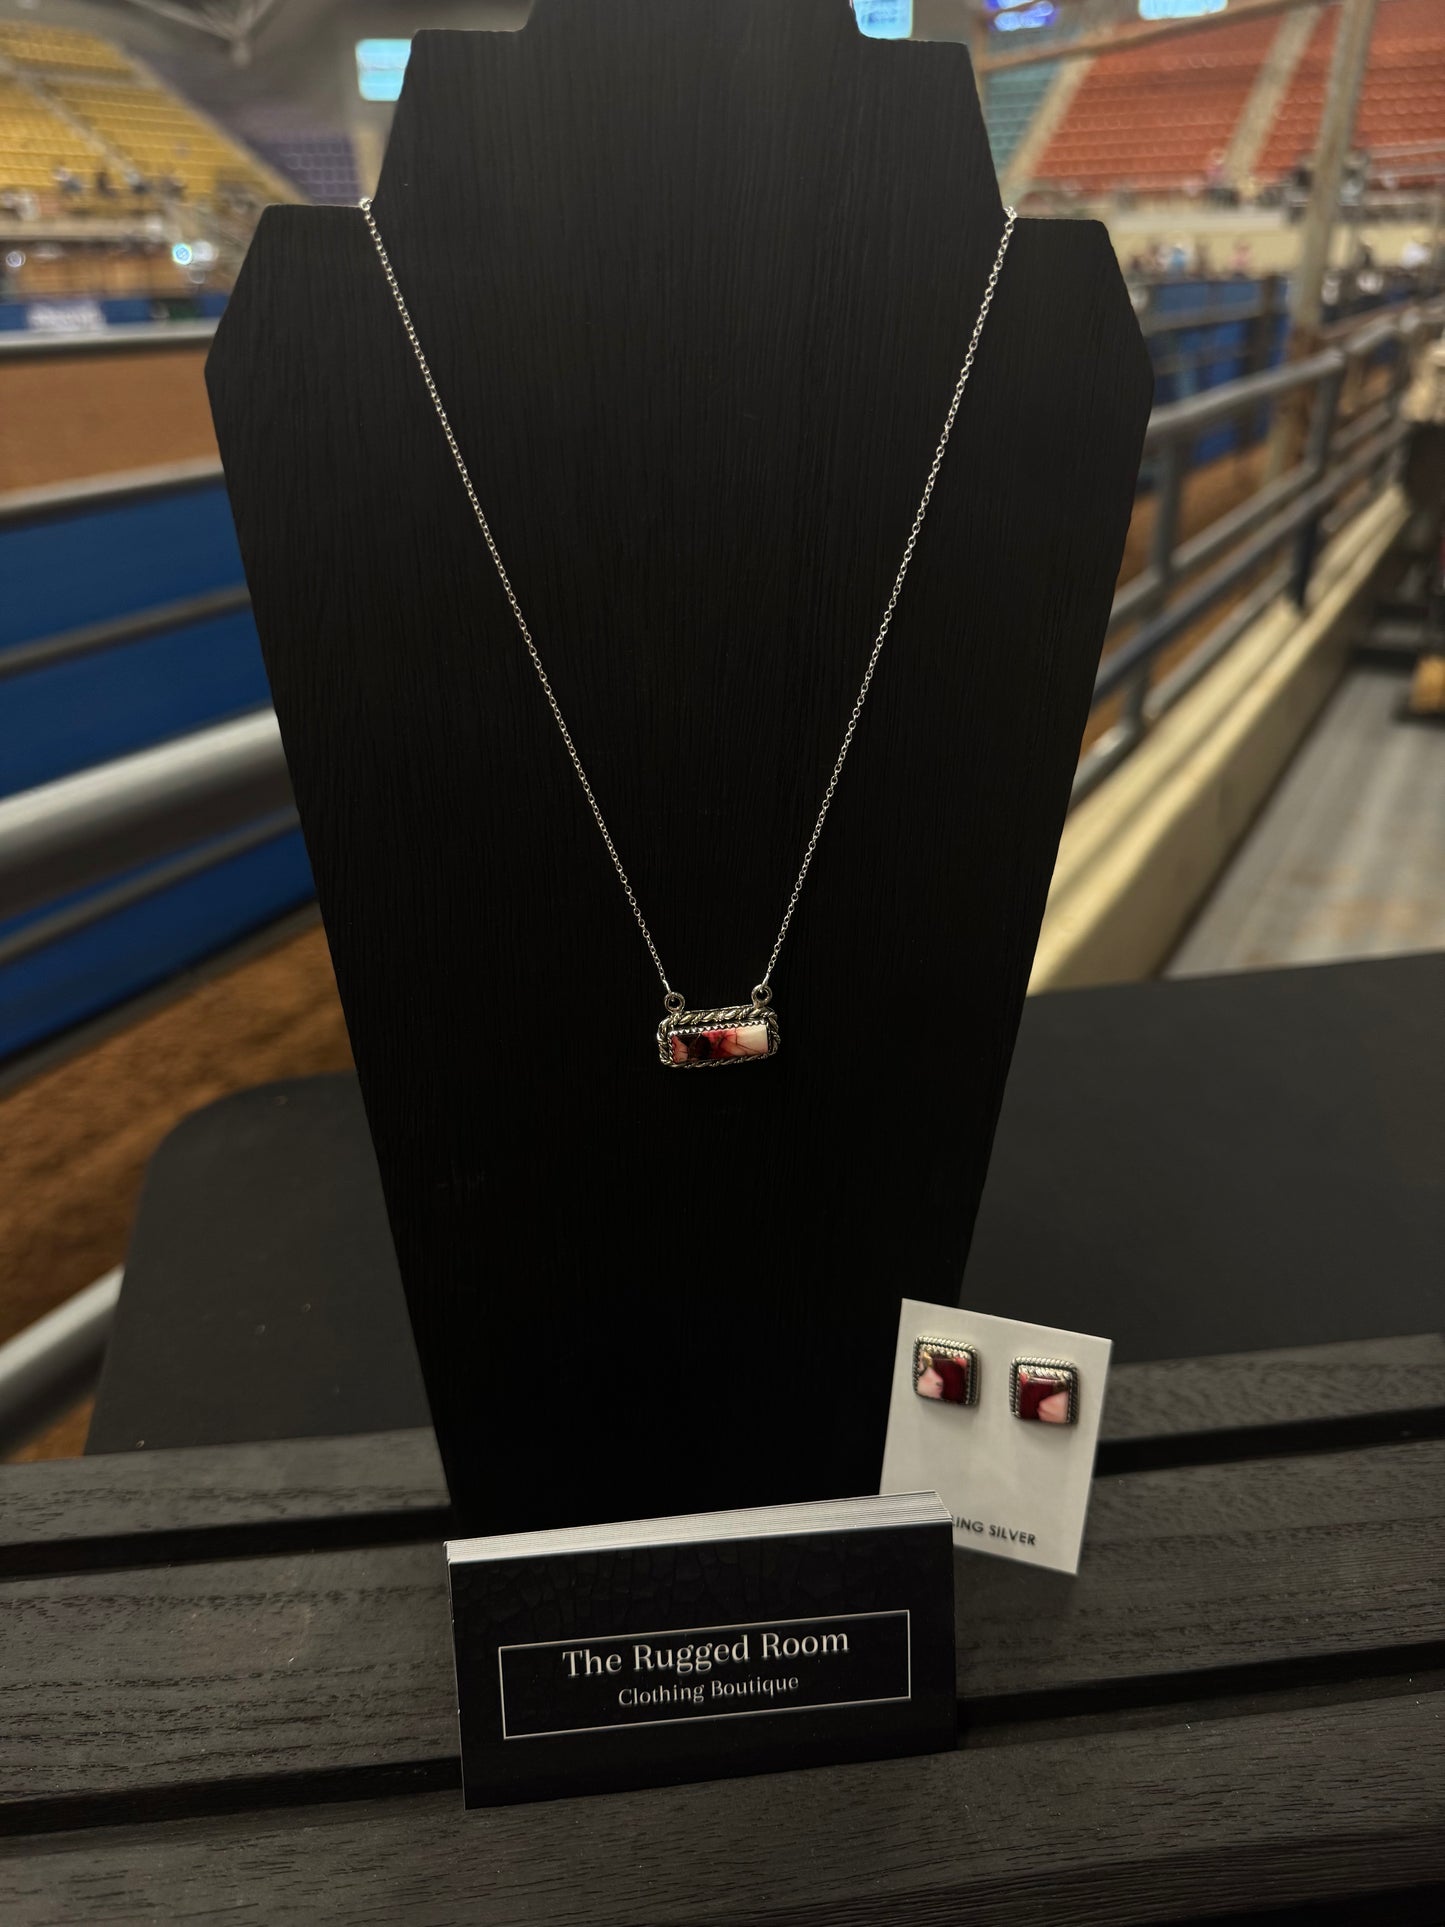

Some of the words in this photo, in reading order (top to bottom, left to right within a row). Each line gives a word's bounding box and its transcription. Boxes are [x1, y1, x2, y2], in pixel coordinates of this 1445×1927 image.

[989, 1525, 1036, 1546] SILVER
[562, 1648, 622, 1677] The
[633, 1635, 750, 1673] Rugged
[761, 1630, 850, 1660] Room
[618, 1684, 705, 1706] Clothing
[711, 1674, 800, 1699] Boutique
